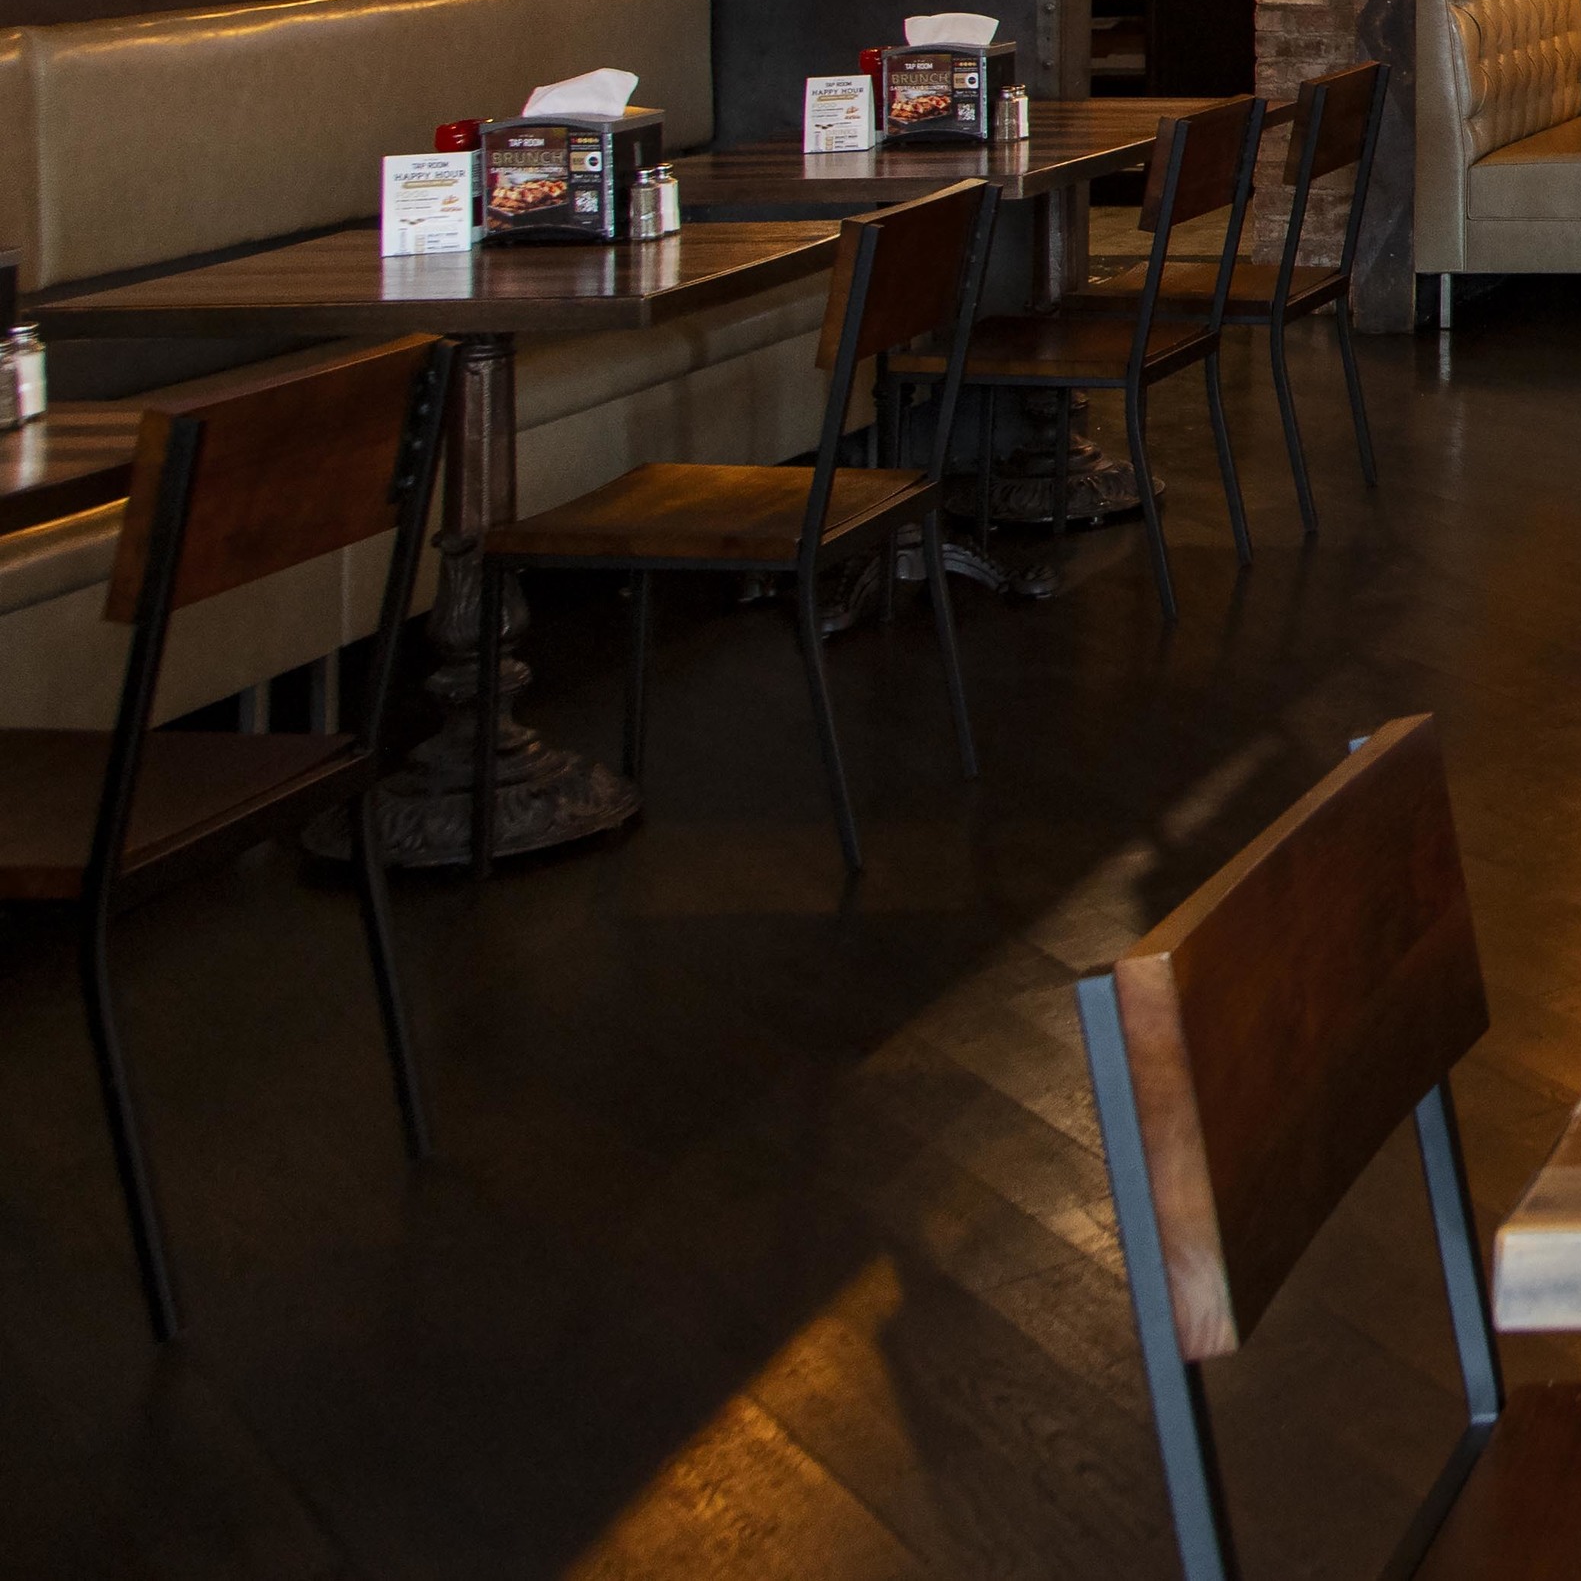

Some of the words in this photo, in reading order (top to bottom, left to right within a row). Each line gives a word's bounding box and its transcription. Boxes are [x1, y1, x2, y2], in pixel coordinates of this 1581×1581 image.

[892, 73, 950, 84] BRUNCH
[492, 151, 563, 165] BRUNCH
[394, 172, 432, 181] HAPPY
[435, 171, 466, 179] HOUR
